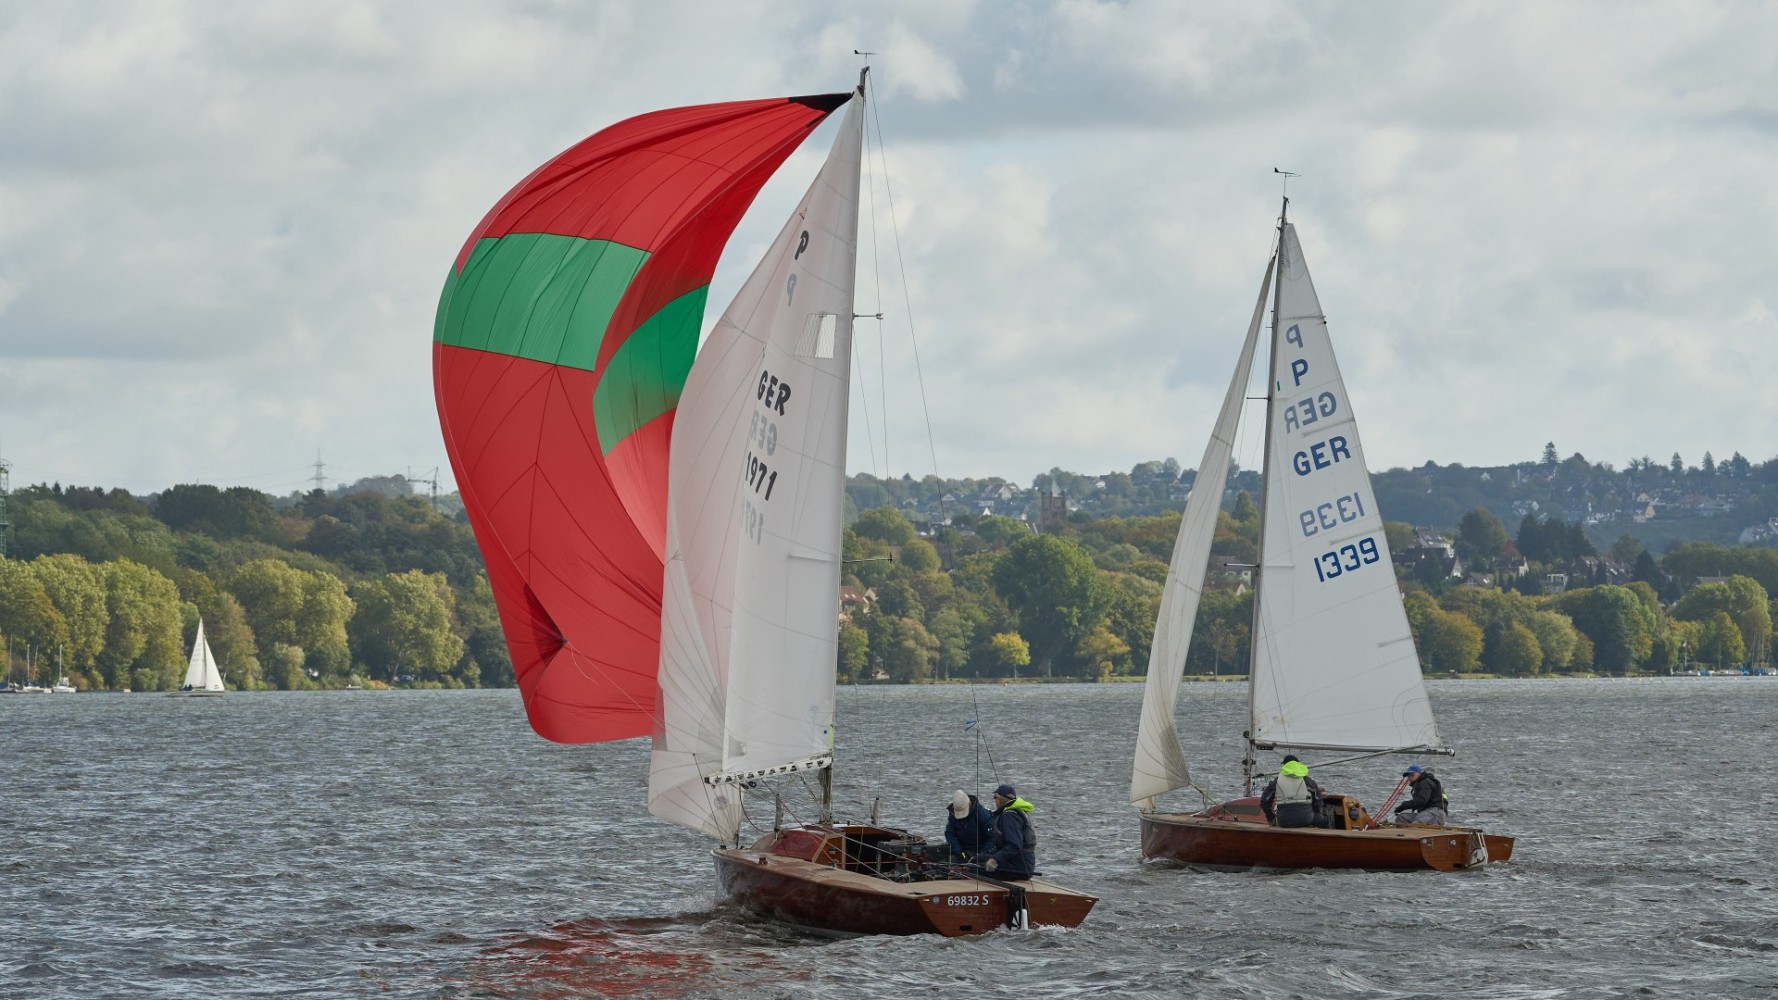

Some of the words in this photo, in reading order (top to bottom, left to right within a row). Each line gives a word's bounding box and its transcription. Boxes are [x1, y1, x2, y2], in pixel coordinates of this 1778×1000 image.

[795, 230, 810, 260] P
[757, 370, 791, 416] GER
[1291, 358, 1309, 387] P
[745, 451, 777, 501] 1971
[1293, 435, 1351, 477] GER
[1313, 537, 1380, 582] 1339
[947, 895, 979, 906] 69832
[982, 894, 989, 905] S
